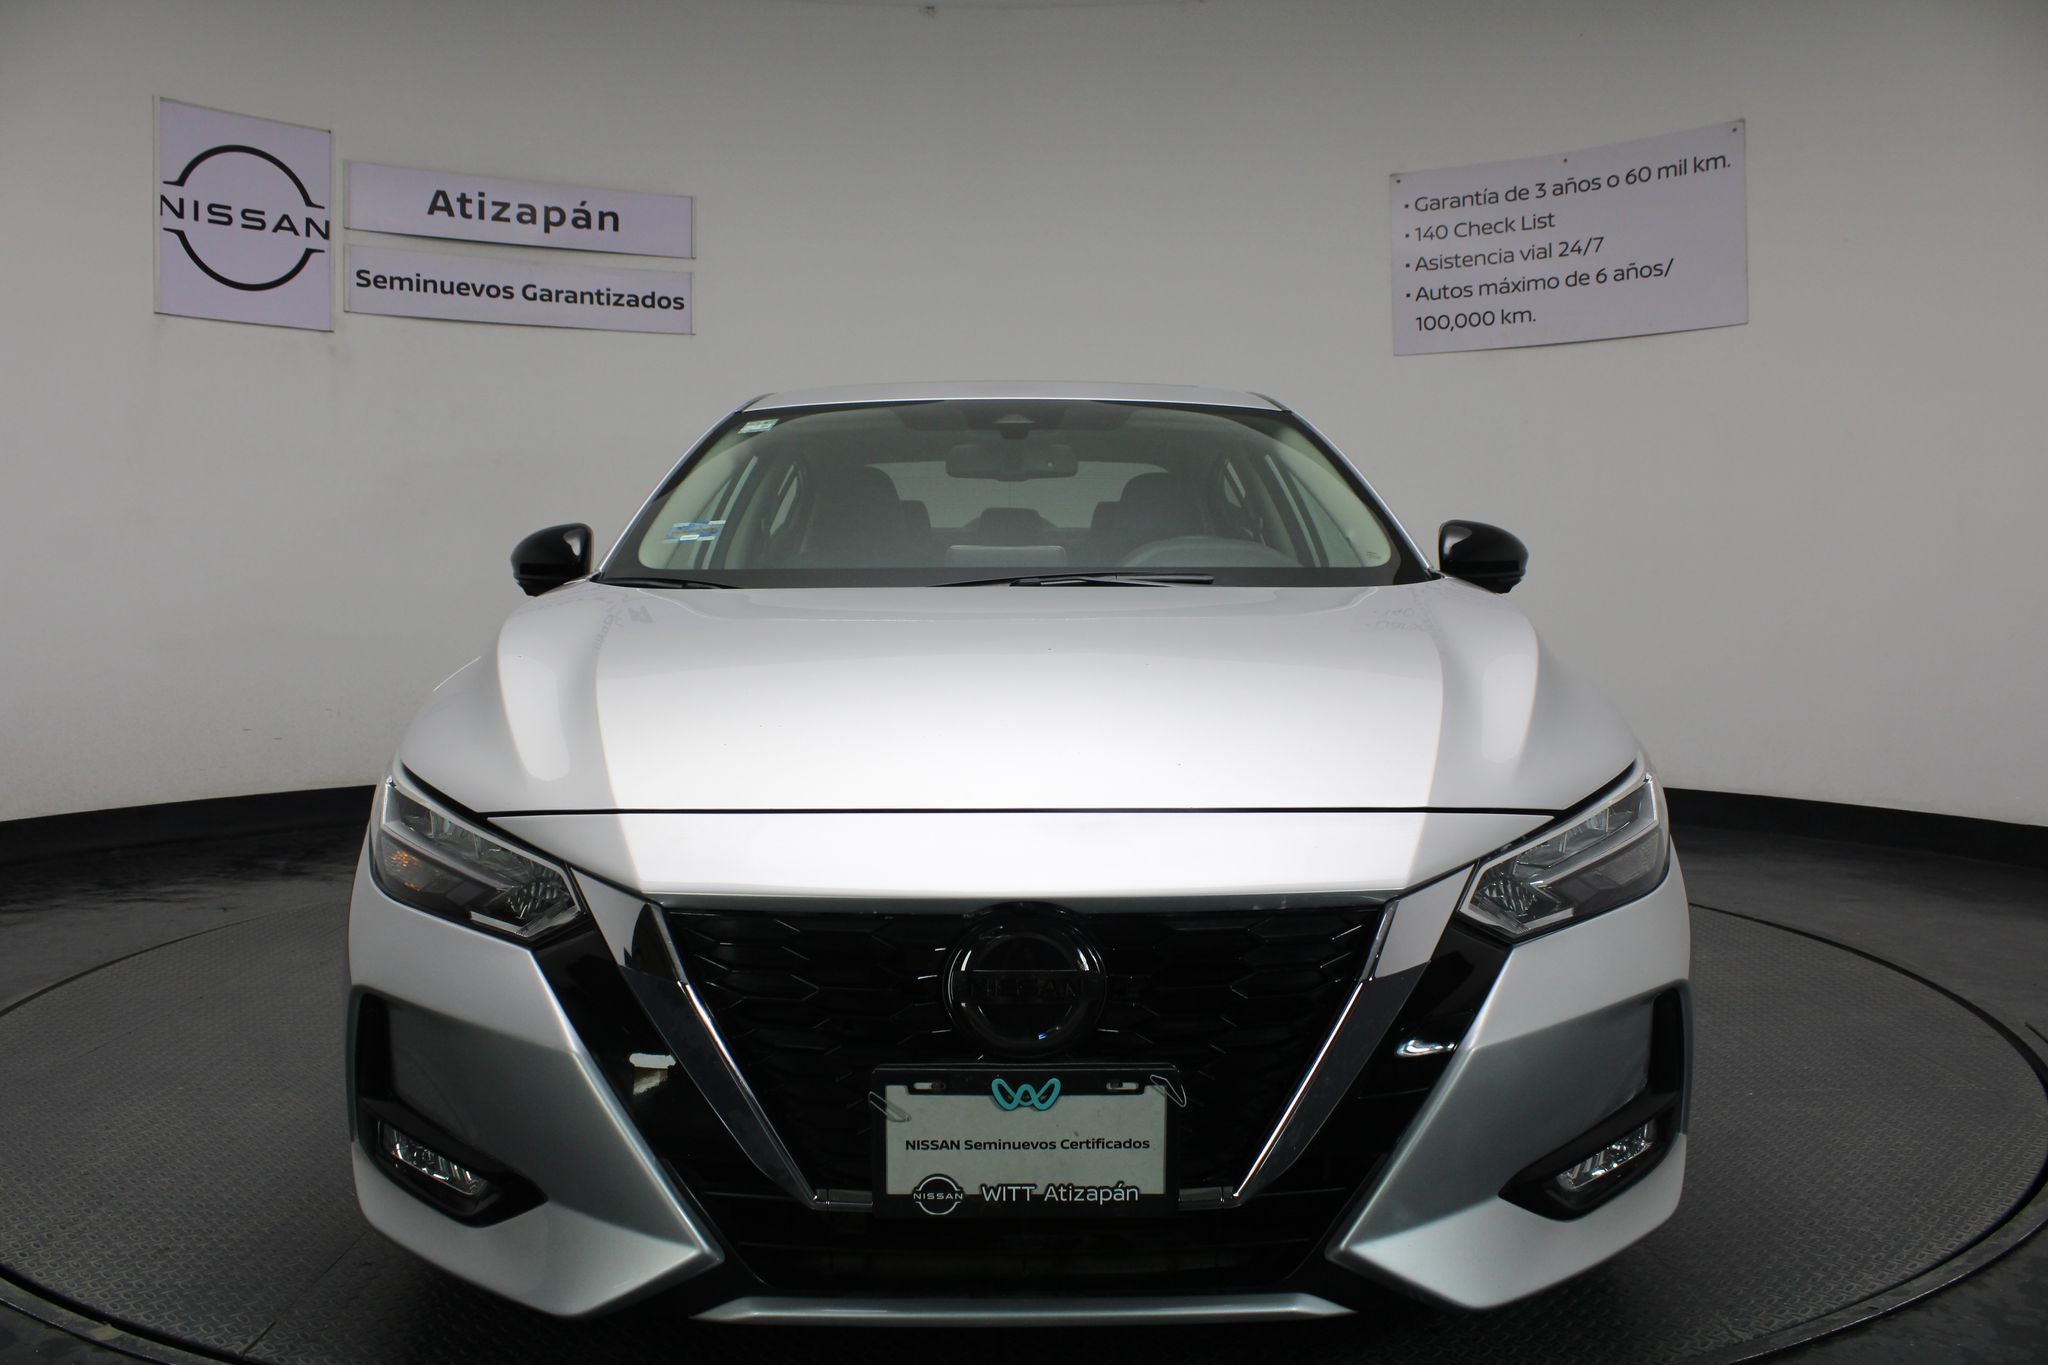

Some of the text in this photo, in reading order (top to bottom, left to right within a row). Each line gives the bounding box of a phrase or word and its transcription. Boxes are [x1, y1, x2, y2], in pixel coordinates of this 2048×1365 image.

[1415, 153, 1731, 212] Garantía de 3 años o 60 mil km.
[160, 194, 330, 240] NISSAN
[427, 189, 620, 234] Atizapán
[1415, 213, 1556, 241] 140 Check List
[1415, 236, 1604, 272] Asistencia vial 24/7
[355, 269, 685, 310] Seminuevos Garantizados
[1415, 258, 1674, 302] Autos máximo de 6 años/
[1416, 309, 1536, 332] 100,000 km.
[906, 1138, 1150, 1150] NISSAN Seminuevos Certificados
[913, 1192, 963, 1200] NISSAN
[981, 1181, 1139, 1205] WITT Atizapán
